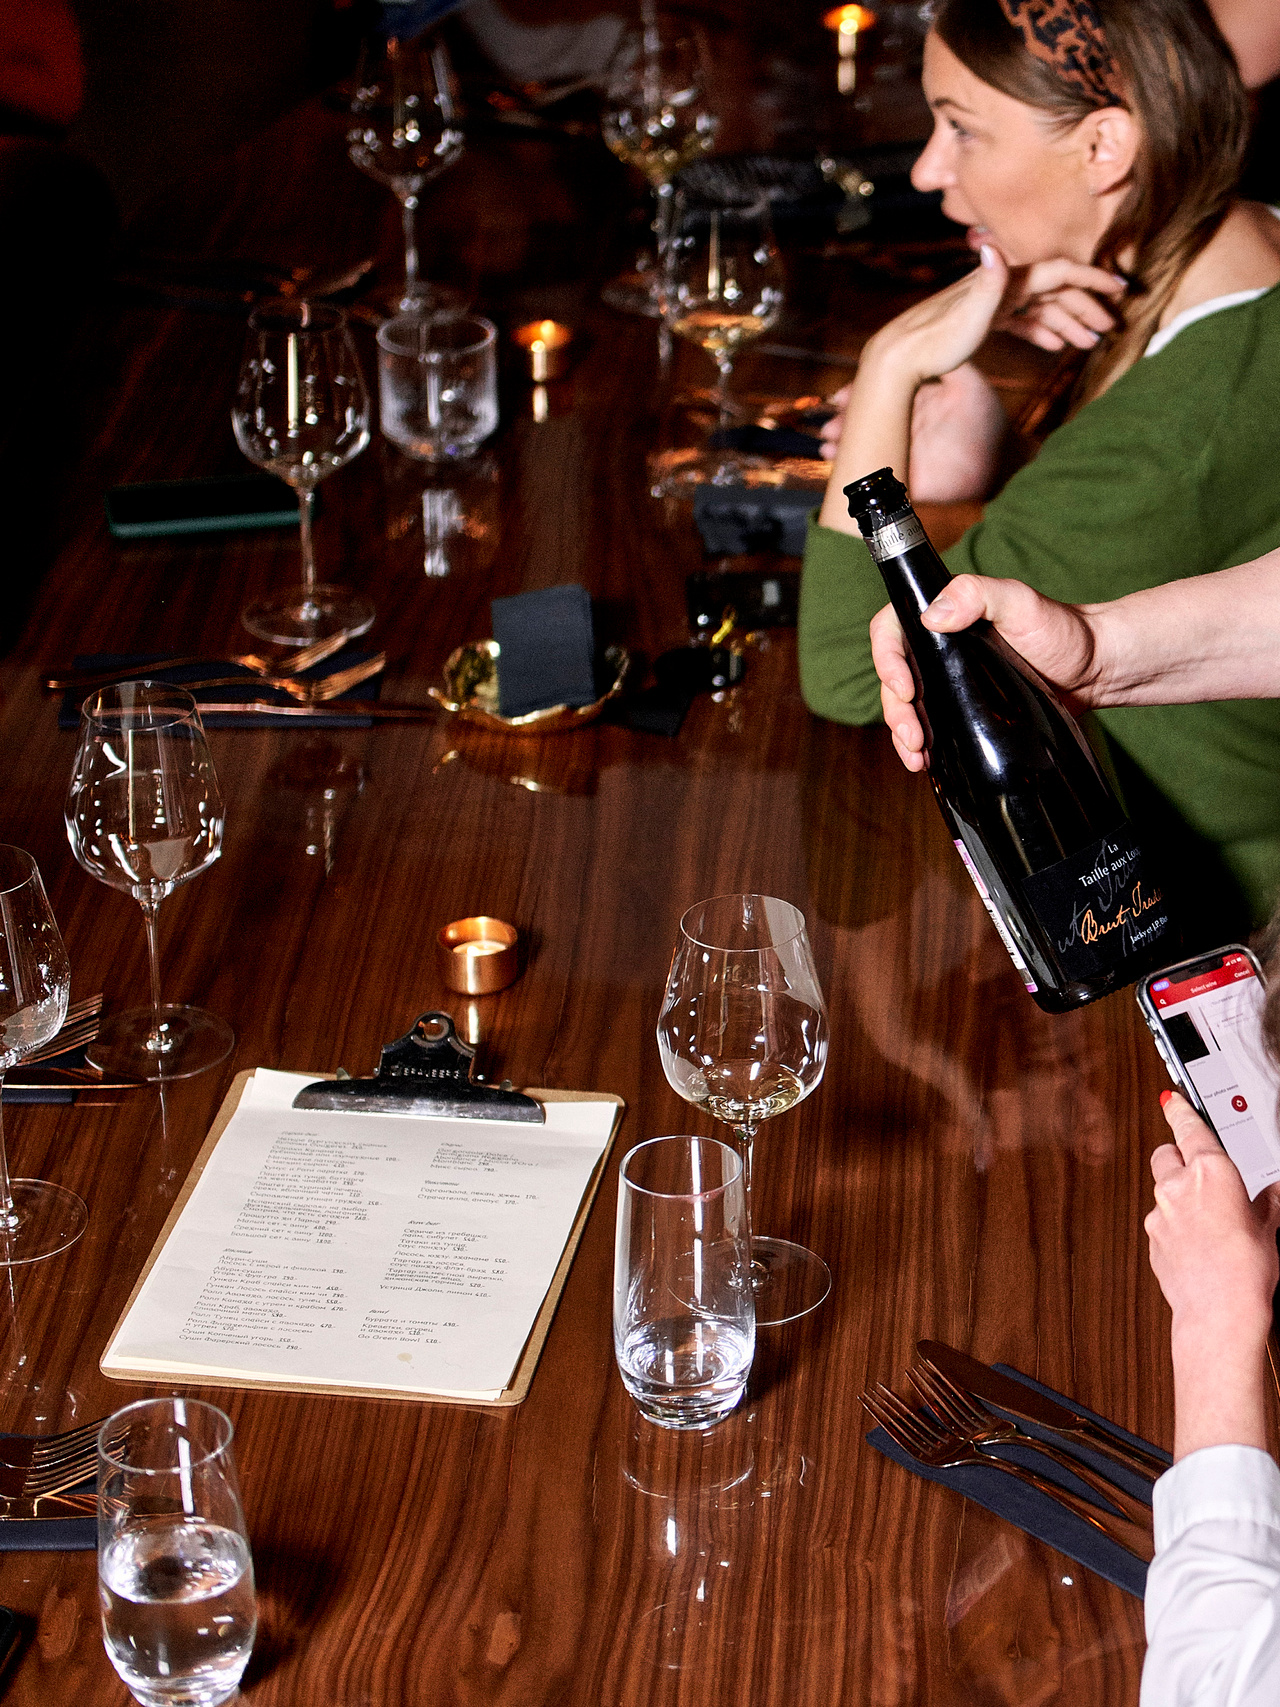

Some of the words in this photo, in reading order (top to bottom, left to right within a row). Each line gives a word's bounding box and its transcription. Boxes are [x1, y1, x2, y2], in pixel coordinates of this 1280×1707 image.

[1107, 844, 1118, 854] La
[1078, 866, 1110, 887] Taille
[1110, 856, 1127, 871] aux
[1081, 904, 1130, 944] Brut
[1234, 969, 1250, 978] Cancel
[1190, 984, 1206, 994] Select
[1206, 980, 1218, 989] wine
